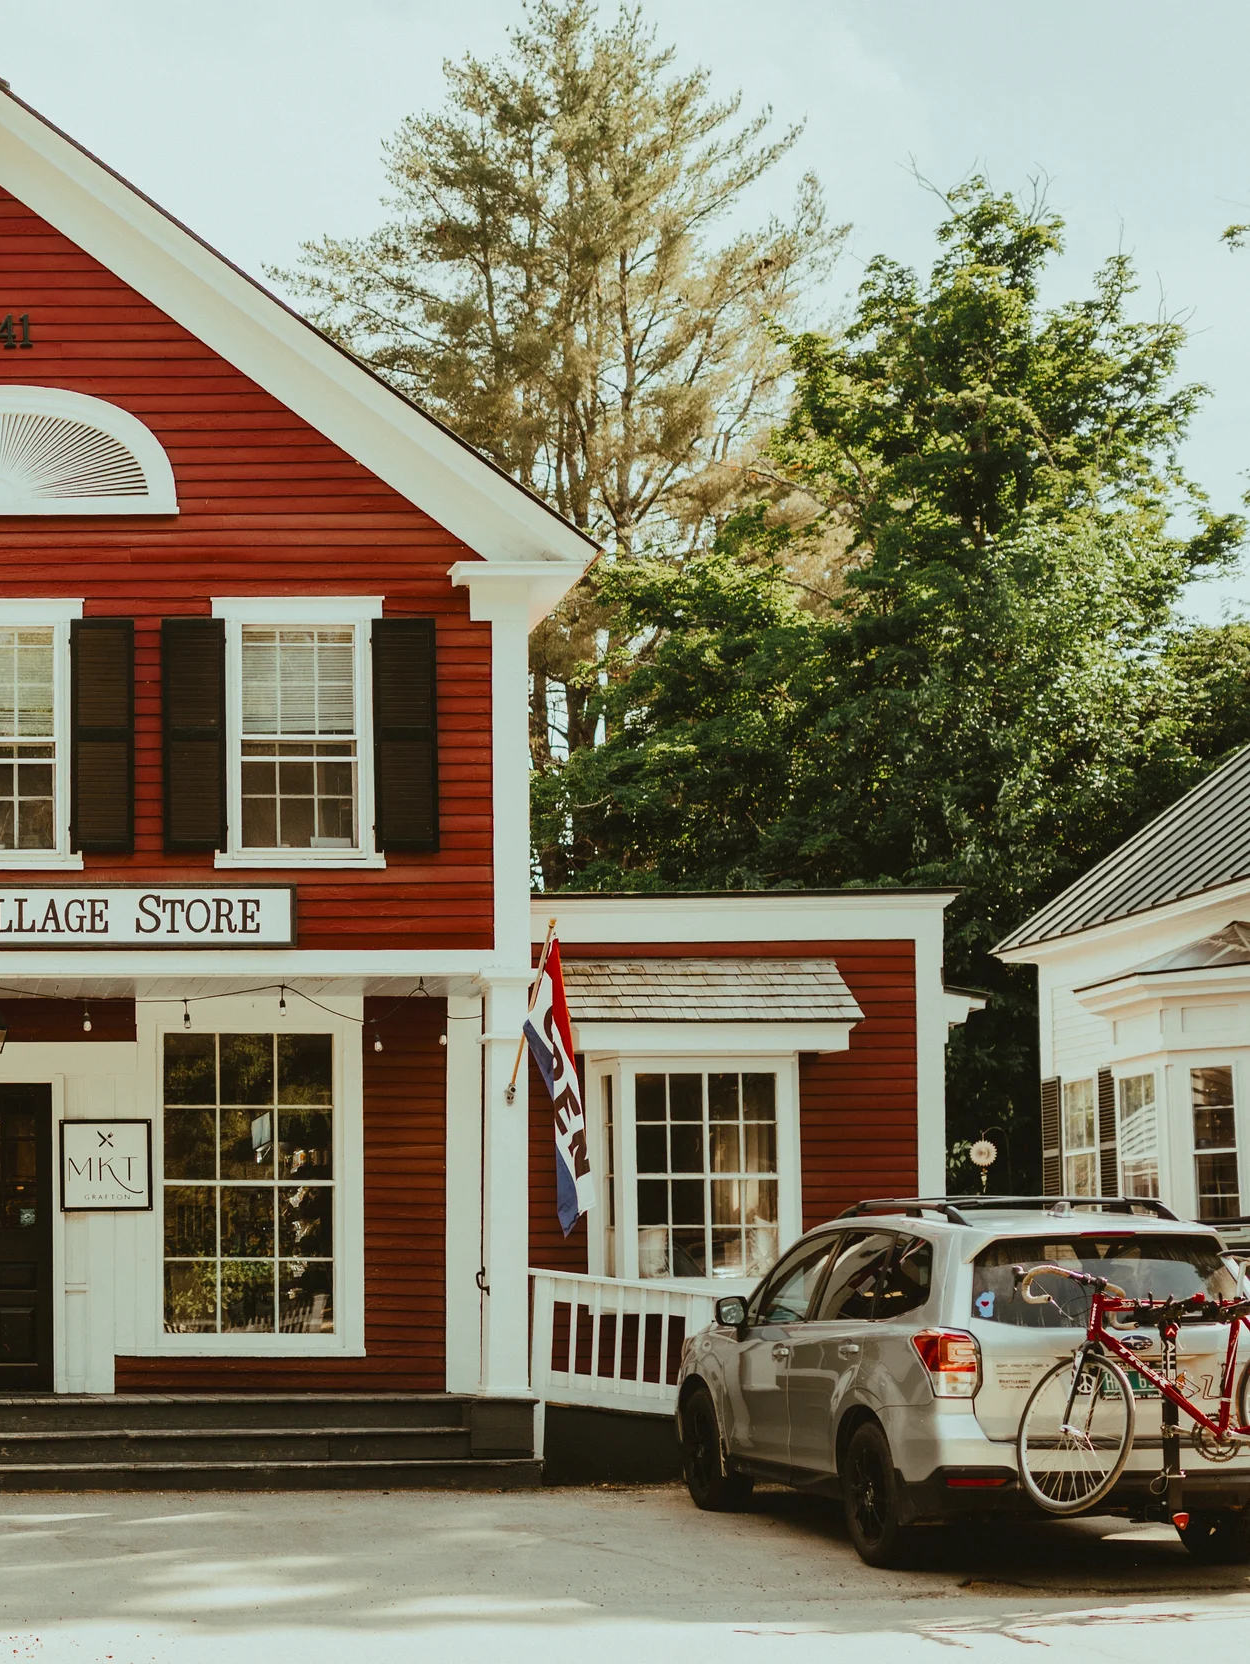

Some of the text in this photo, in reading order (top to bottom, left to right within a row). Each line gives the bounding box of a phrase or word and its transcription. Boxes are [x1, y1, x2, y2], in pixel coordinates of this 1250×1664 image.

[135, 894, 261, 934] STORE
[68, 1156, 144, 1194] MKT
[1117, 1342, 1171, 1388] TREK
